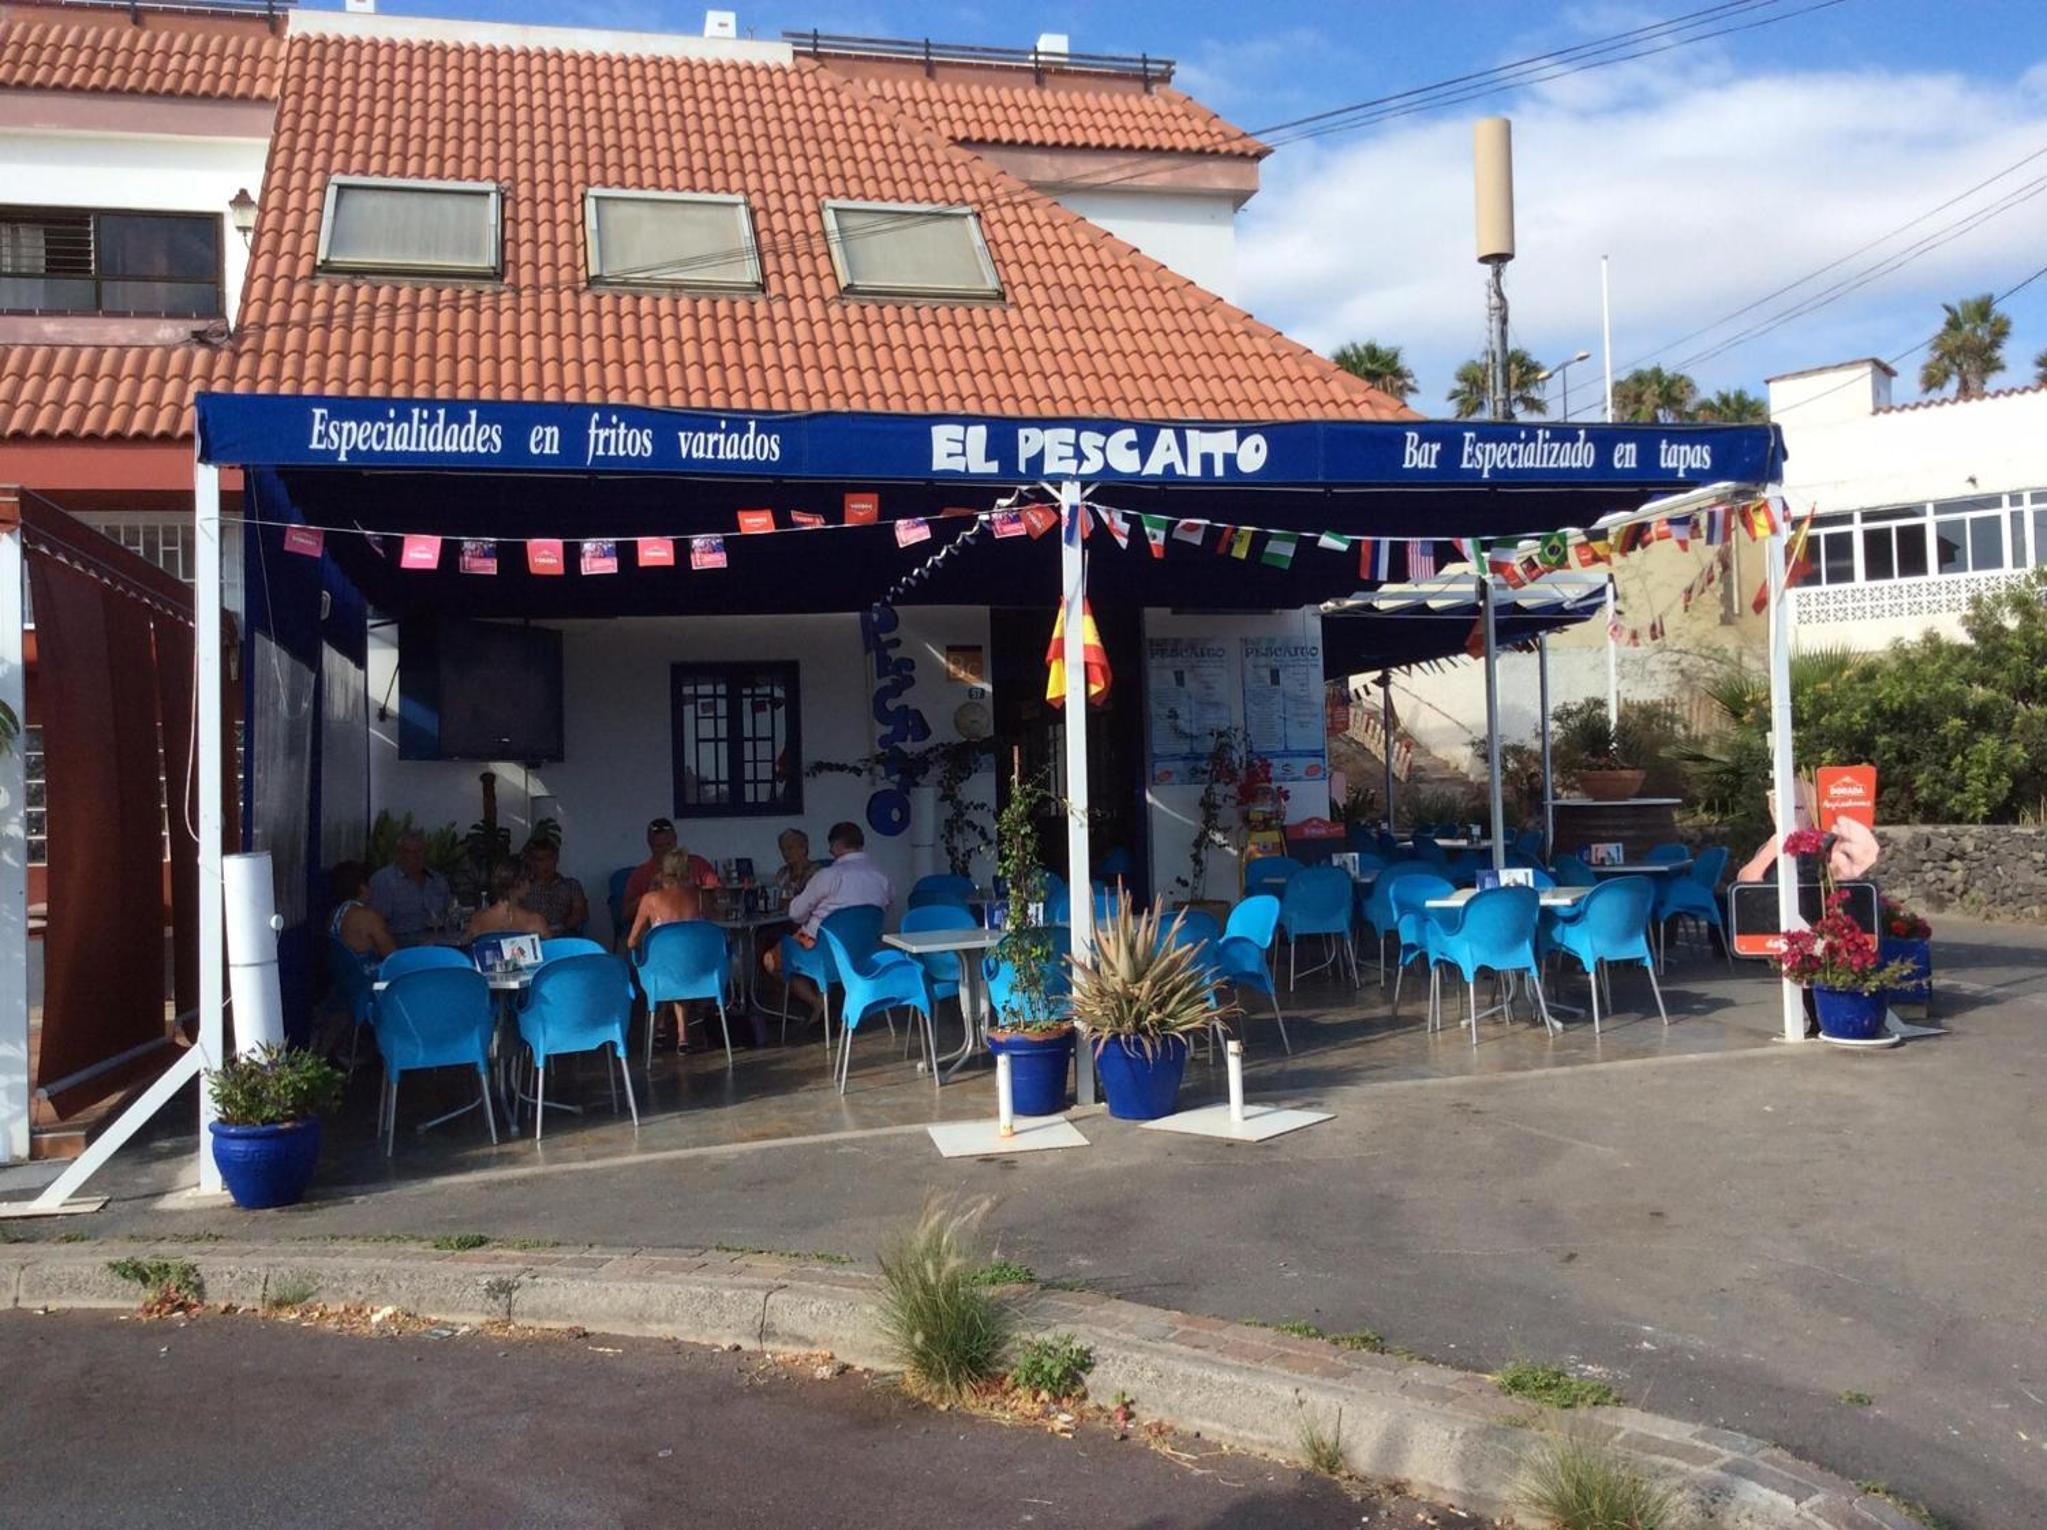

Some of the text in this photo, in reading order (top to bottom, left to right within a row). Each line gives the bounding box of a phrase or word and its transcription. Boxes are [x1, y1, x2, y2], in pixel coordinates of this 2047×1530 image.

[309, 407, 781, 466] Especialidades en fritos variados
[931, 424, 1268, 477] EL PESCAITO
[1403, 429, 1711, 478] Bar Especializado en tapas
